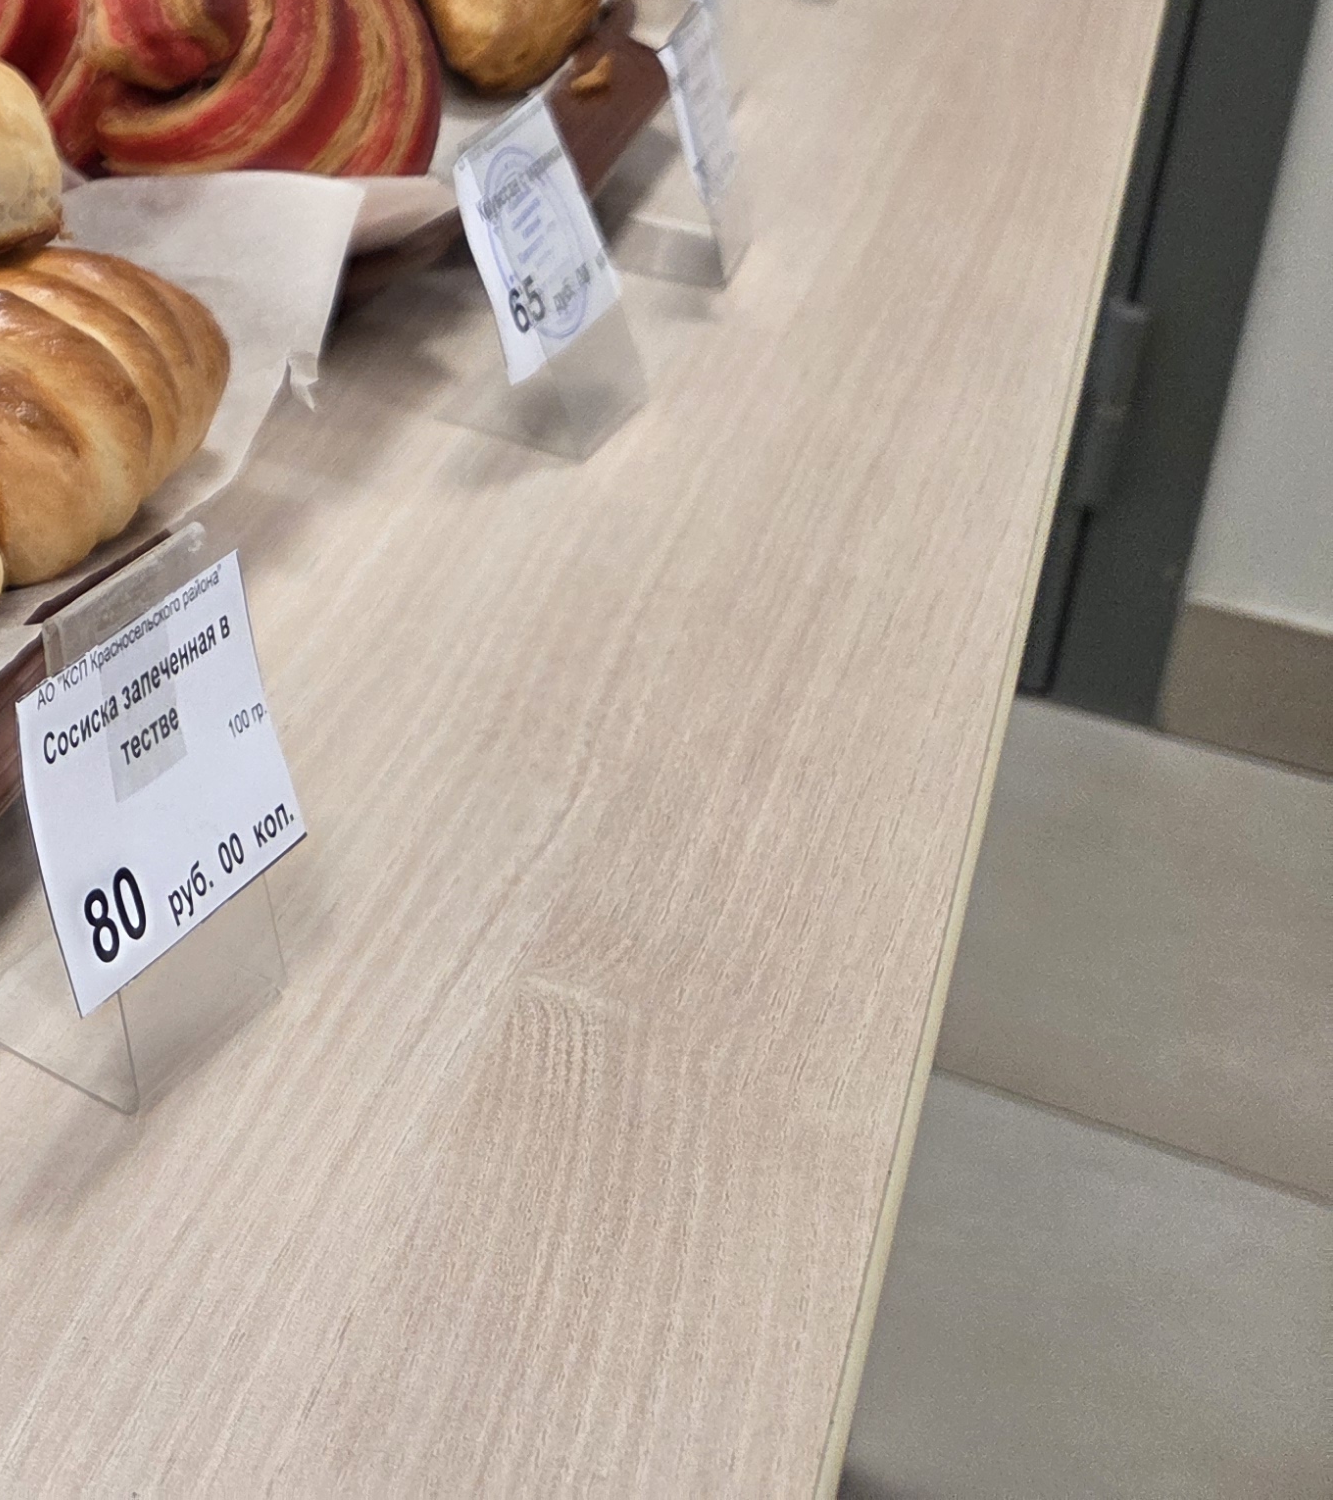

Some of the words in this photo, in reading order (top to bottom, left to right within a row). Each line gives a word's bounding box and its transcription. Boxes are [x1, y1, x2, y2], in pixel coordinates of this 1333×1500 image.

[509, 275, 546, 334] 65
[37, 682, 56, 710] АО
[58, 656, 87, 693] "КСП
[89, 597, 181, 670] Красносельского
[182, 563, 222, 610] района"
[43, 695, 119, 764] Сосиска
[121, 624, 217, 710] запеченная
[219, 615, 231, 639] в
[120, 707, 180, 765] тестве
[228, 709, 251, 738] 100
[251, 702, 268, 723] гр.
[83, 866, 147, 964] 80
[167, 860, 214, 926] руб.
[217, 833, 246, 875] 00
[254, 802, 295, 848] коп.
